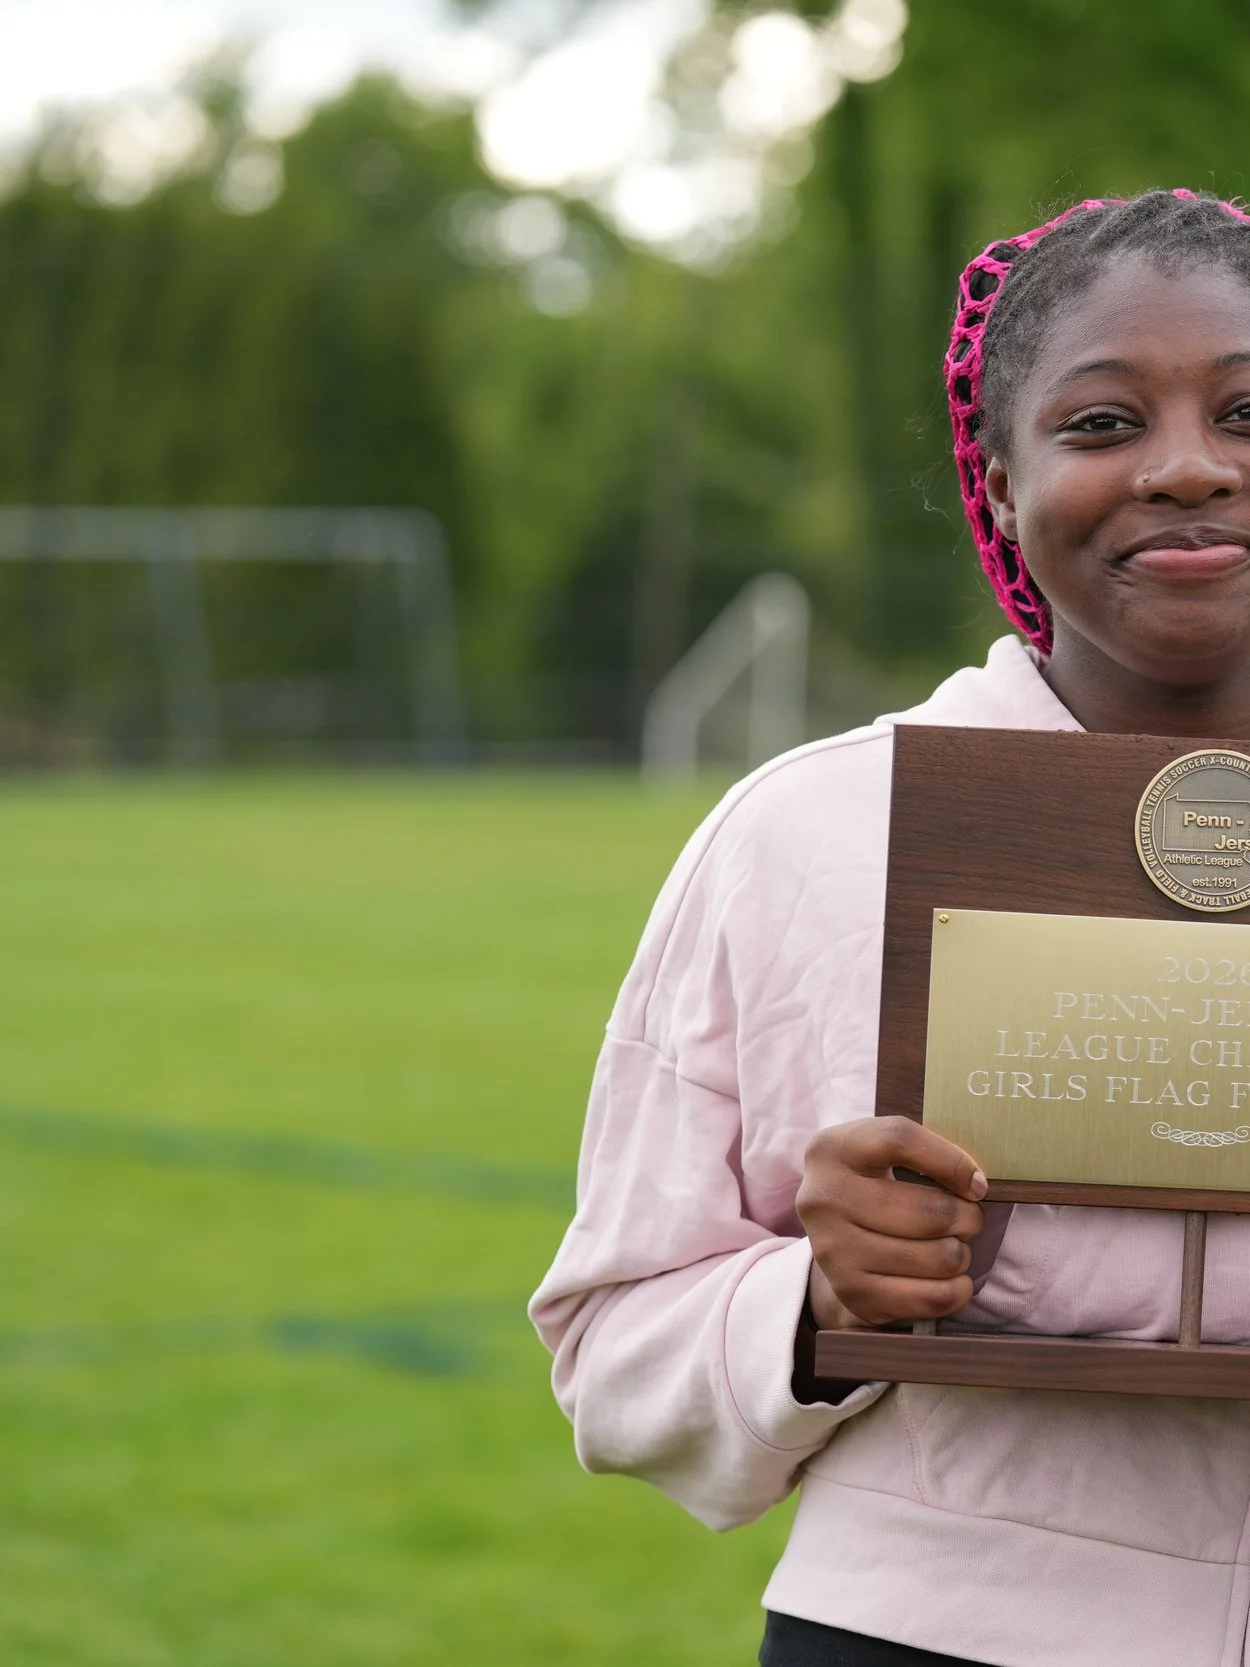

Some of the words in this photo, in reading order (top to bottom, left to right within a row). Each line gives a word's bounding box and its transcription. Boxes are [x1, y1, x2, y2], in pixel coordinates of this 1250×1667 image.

[1171, 756, 1207, 778] SOCCER
[1147, 776, 1171, 809] TENNIS
[1183, 811, 1232, 828] Penn
[1141, 809, 1158, 868] VOLLEYBALL
[1163, 853, 1202, 865] Athletic
[1204, 854, 1243, 868] League
[1155, 869, 1180, 893] FIELD
[1192, 877, 1238, 888] est.1991
[1180, 888, 1189, 899] &
[1189, 893, 1221, 907] TRACK
[996, 1030, 1172, 1065] LEAGUE
[966, 1069, 1088, 1102] GIRLS
[1105, 1076, 1211, 1108] FLAG
